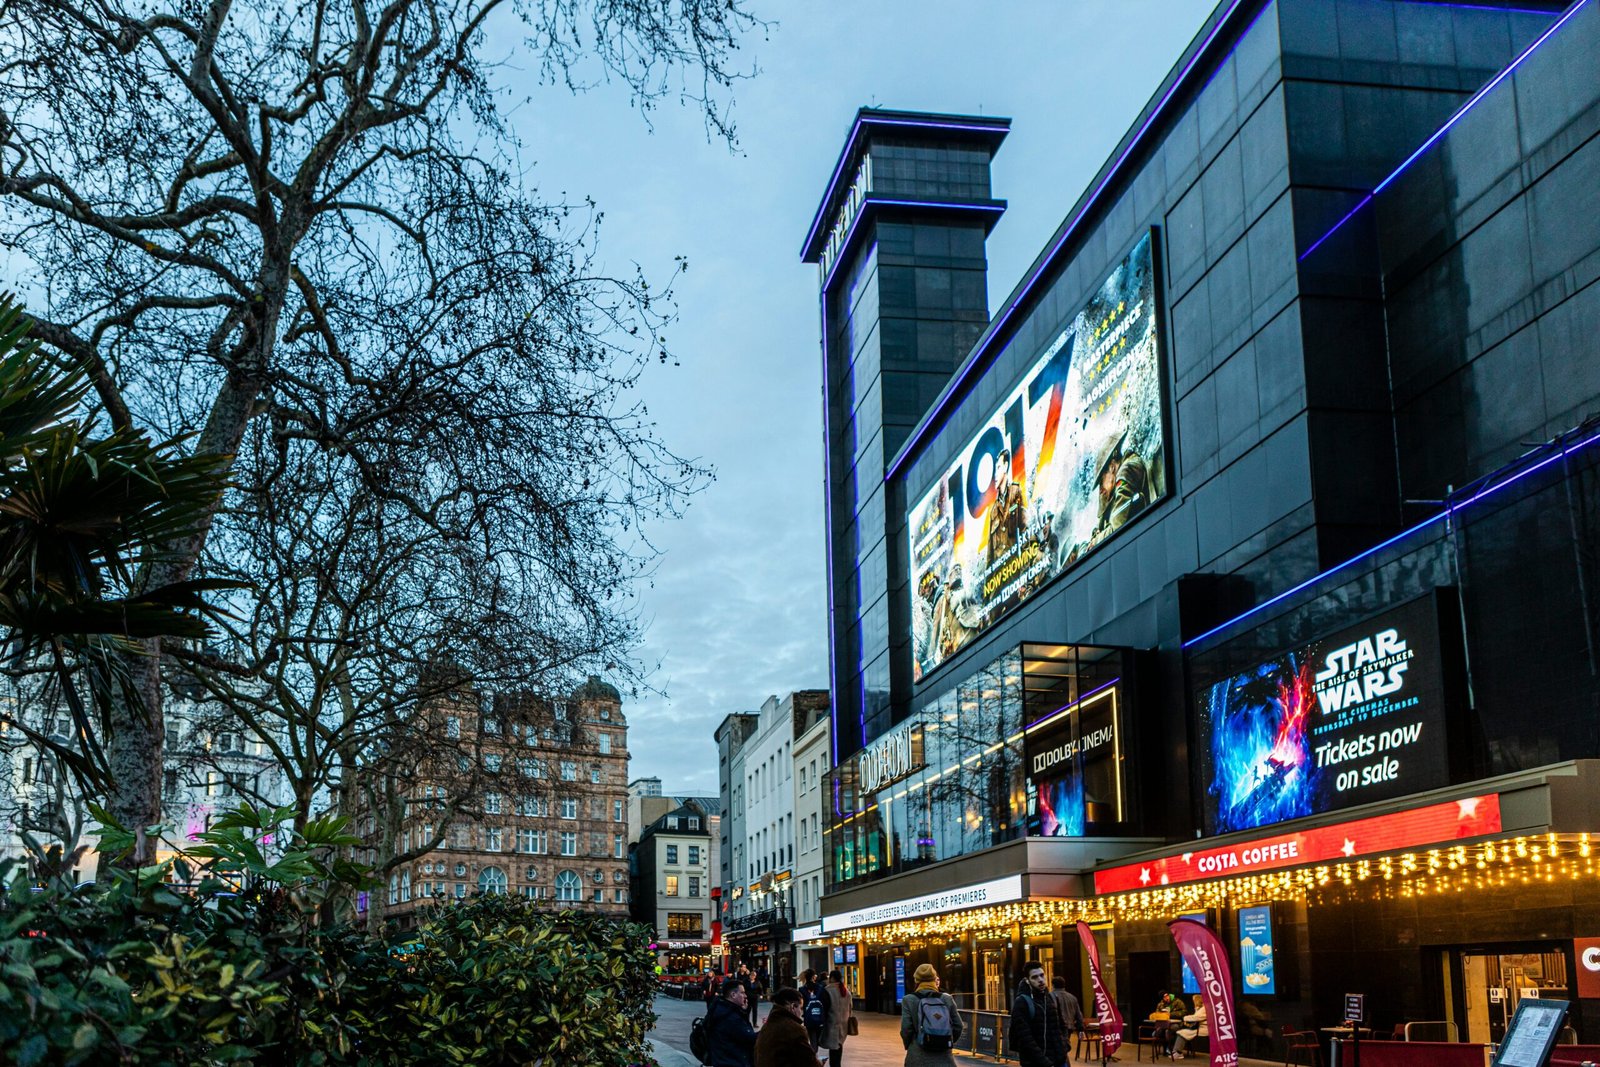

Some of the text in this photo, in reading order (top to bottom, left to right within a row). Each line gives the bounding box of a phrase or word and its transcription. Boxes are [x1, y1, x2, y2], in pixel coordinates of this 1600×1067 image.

[948, 331, 1076, 562] 1917
[1018, 514, 1050, 547] SKYFALL
[983, 542, 1038, 597] NOW SHOWING
[1312, 649, 1414, 693] THE RISE OF SKYWALKER
[1315, 628, 1406, 682] STAR
[1317, 661, 1408, 715] WARS
[1314, 697, 1419, 735] THURSDAY 19 DECEMBER
[1338, 698, 1389, 720] IN CINEMAS
[1046, 740, 1077, 767] DOLBY
[1315, 722, 1423, 768] Tickets now
[1336, 756, 1400, 792] on sale
[1198, 841, 1298, 872] COSTA COFFEE
[876, 906, 900, 919] LEICESTER
[900, 902, 921, 916] SQUARE
[922, 898, 939, 910] HOME
[940, 898, 949, 908] OF
[950, 889, 987, 906] PREMIERES
